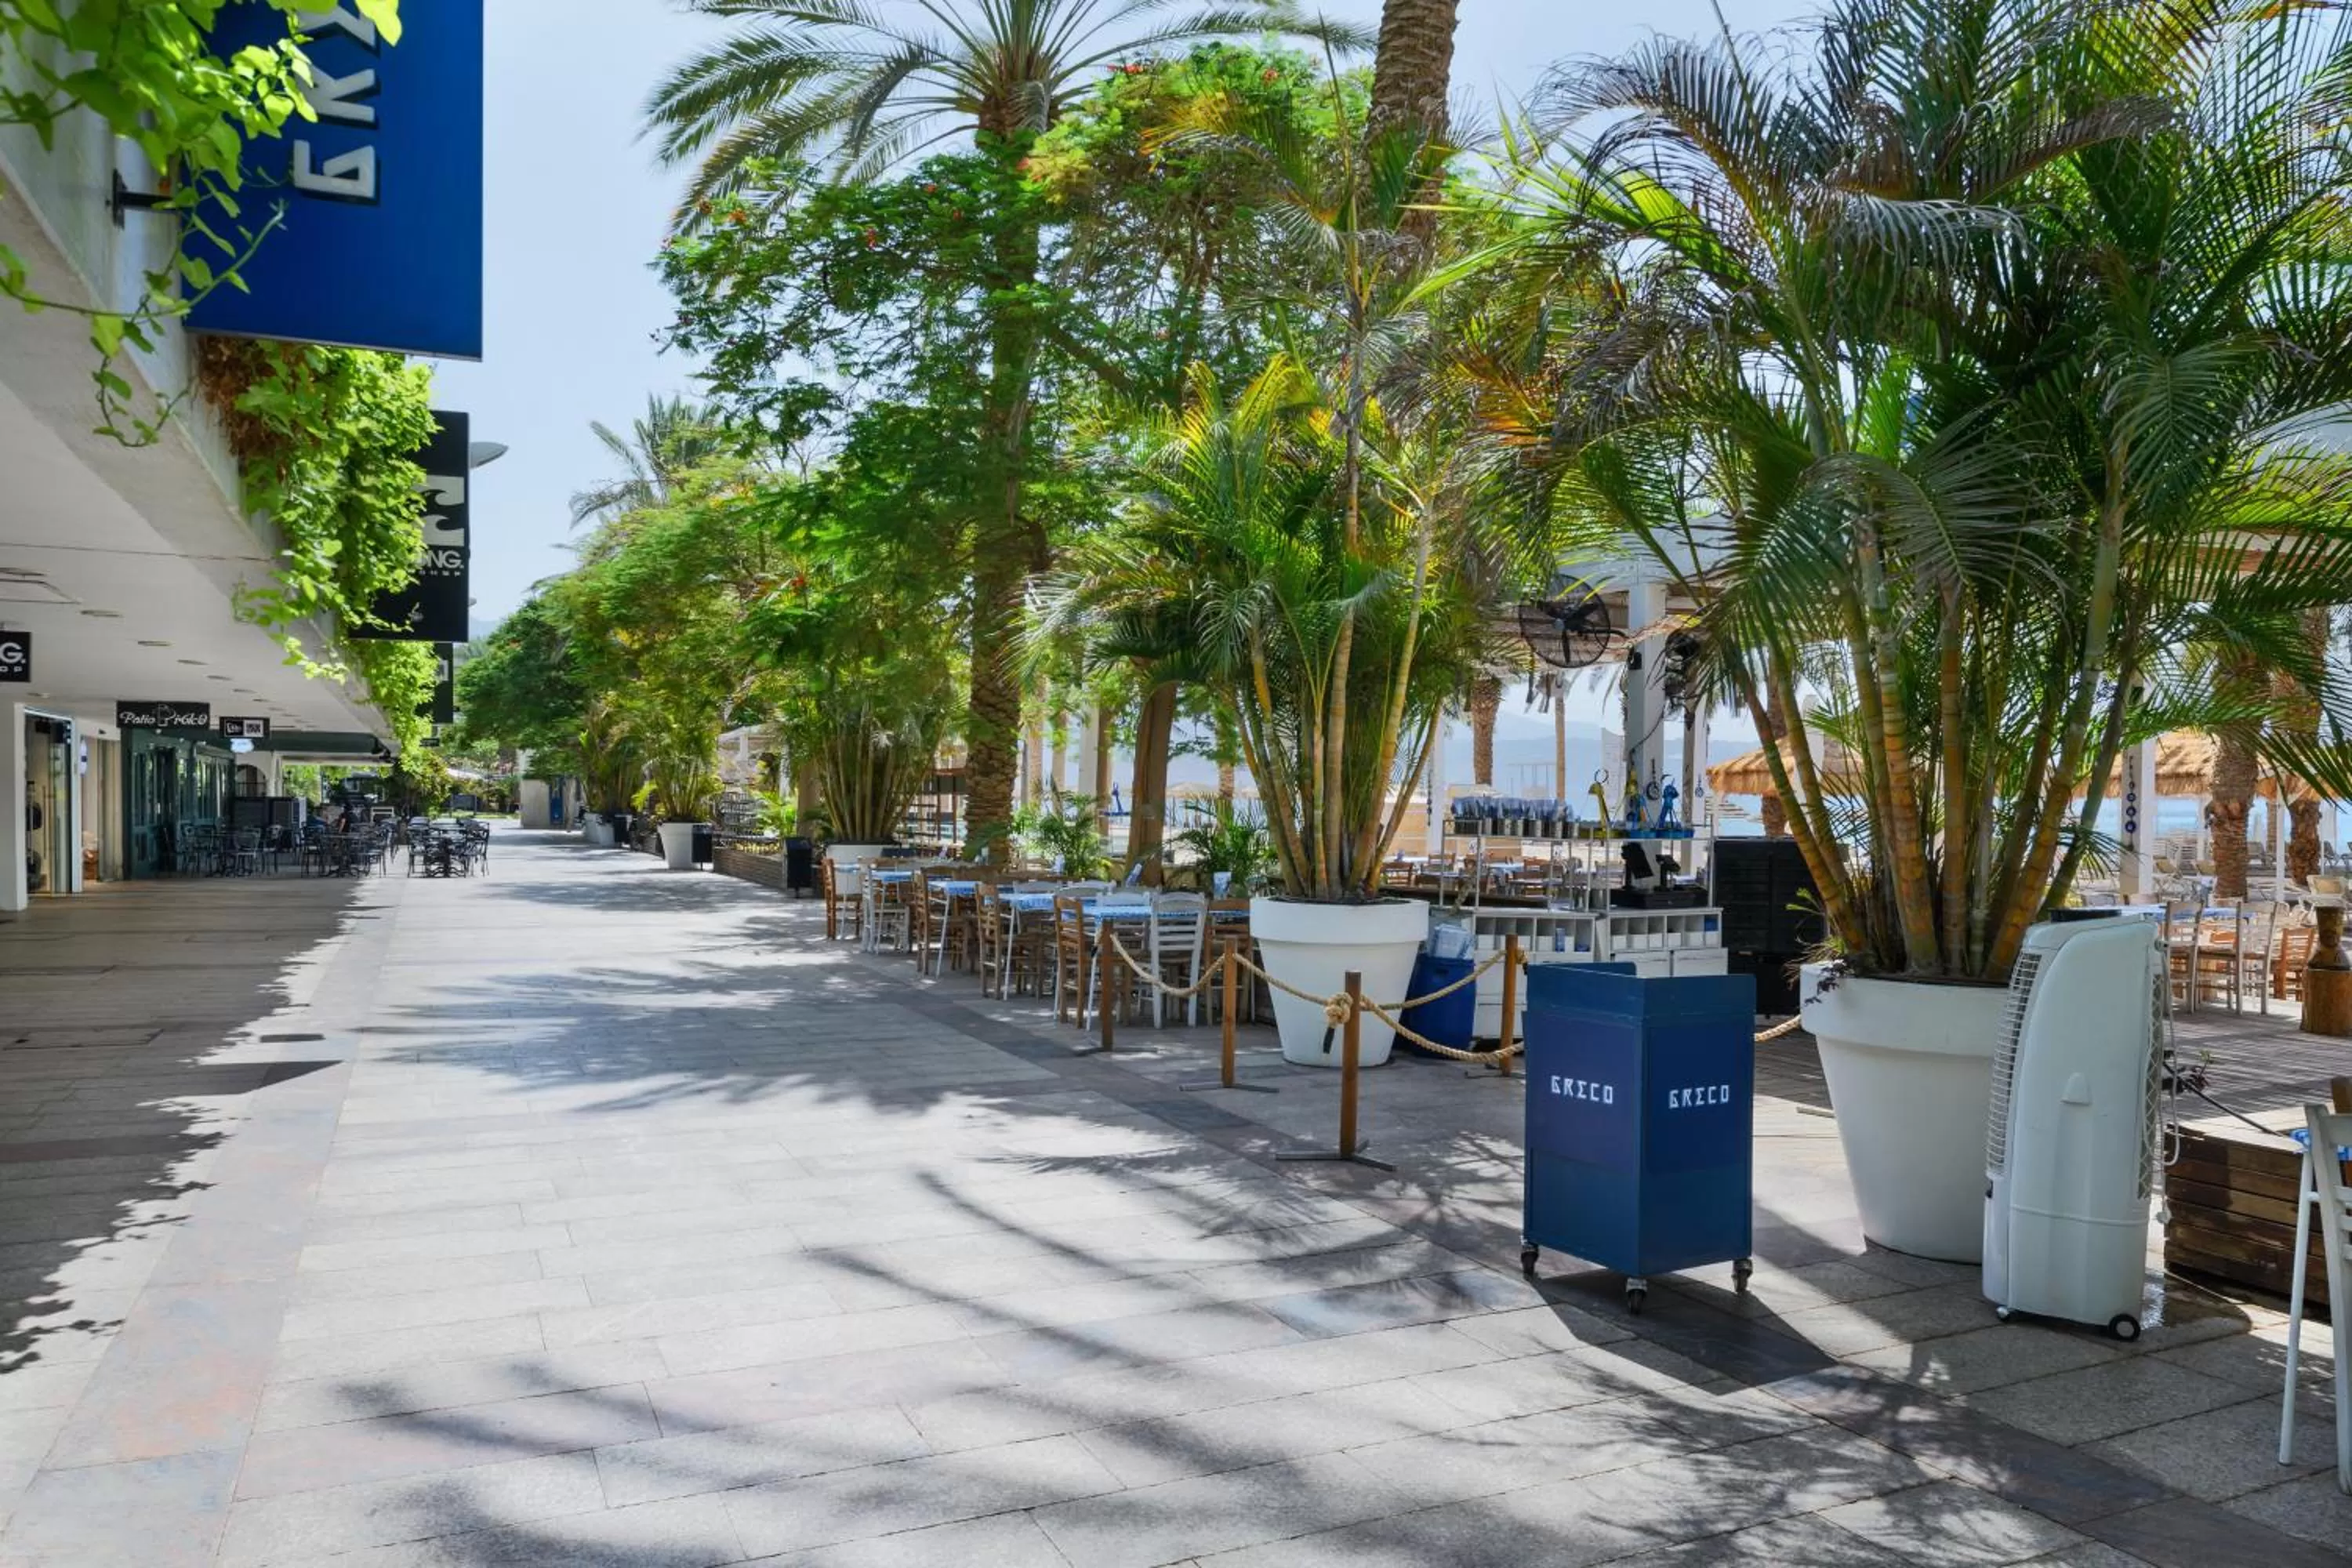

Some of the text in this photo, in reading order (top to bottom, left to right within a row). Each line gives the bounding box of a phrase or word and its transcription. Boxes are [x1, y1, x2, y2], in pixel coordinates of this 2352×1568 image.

[119, 711, 156, 724] Patio
[1551, 1075, 1613, 1105] GRECO
[1668, 1084, 1730, 1109] GRECO
